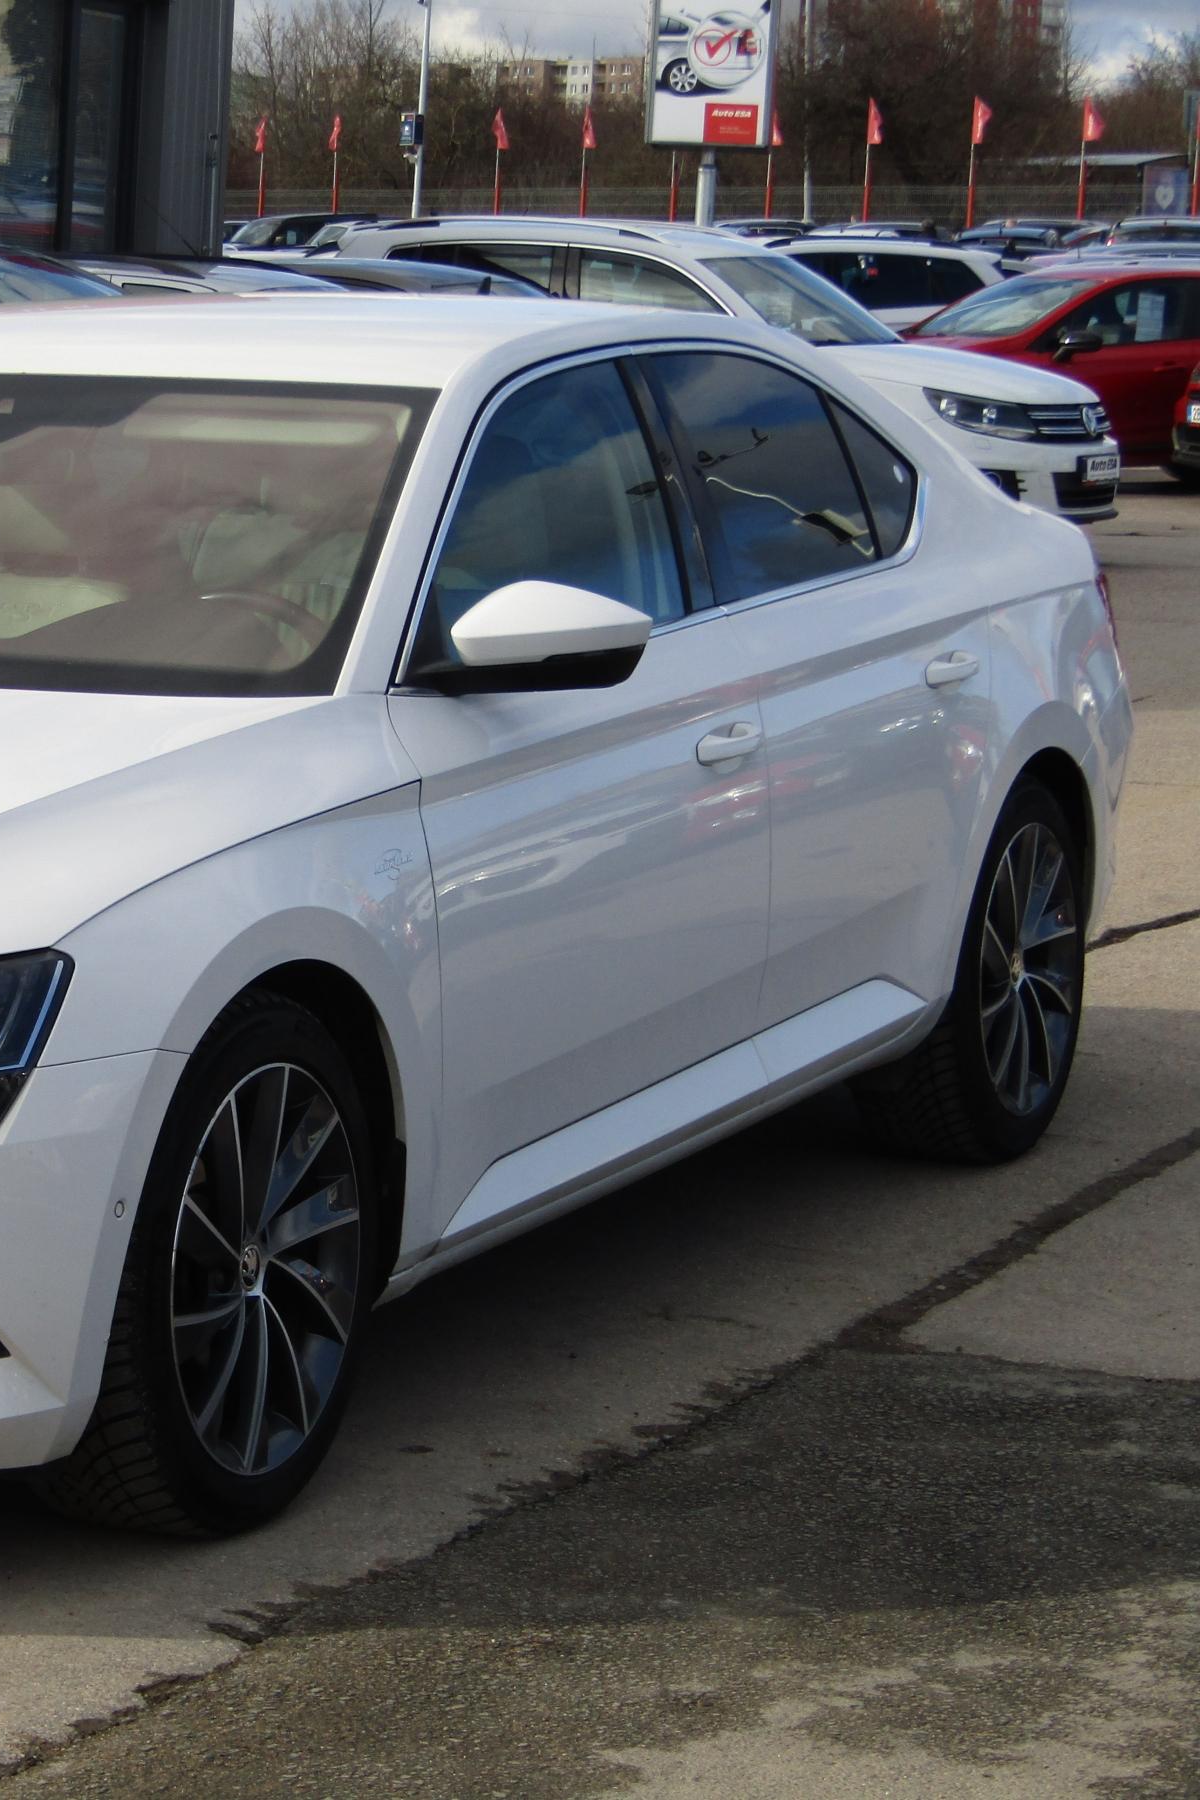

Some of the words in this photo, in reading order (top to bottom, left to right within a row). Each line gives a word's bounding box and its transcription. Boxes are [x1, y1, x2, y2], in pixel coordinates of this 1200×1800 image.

[711, 109, 734, 118] Auto
[734, 110, 752, 118] ESA
[1090, 460, 1107, 473] Auto
[1107, 458, 1118, 471] ESA
